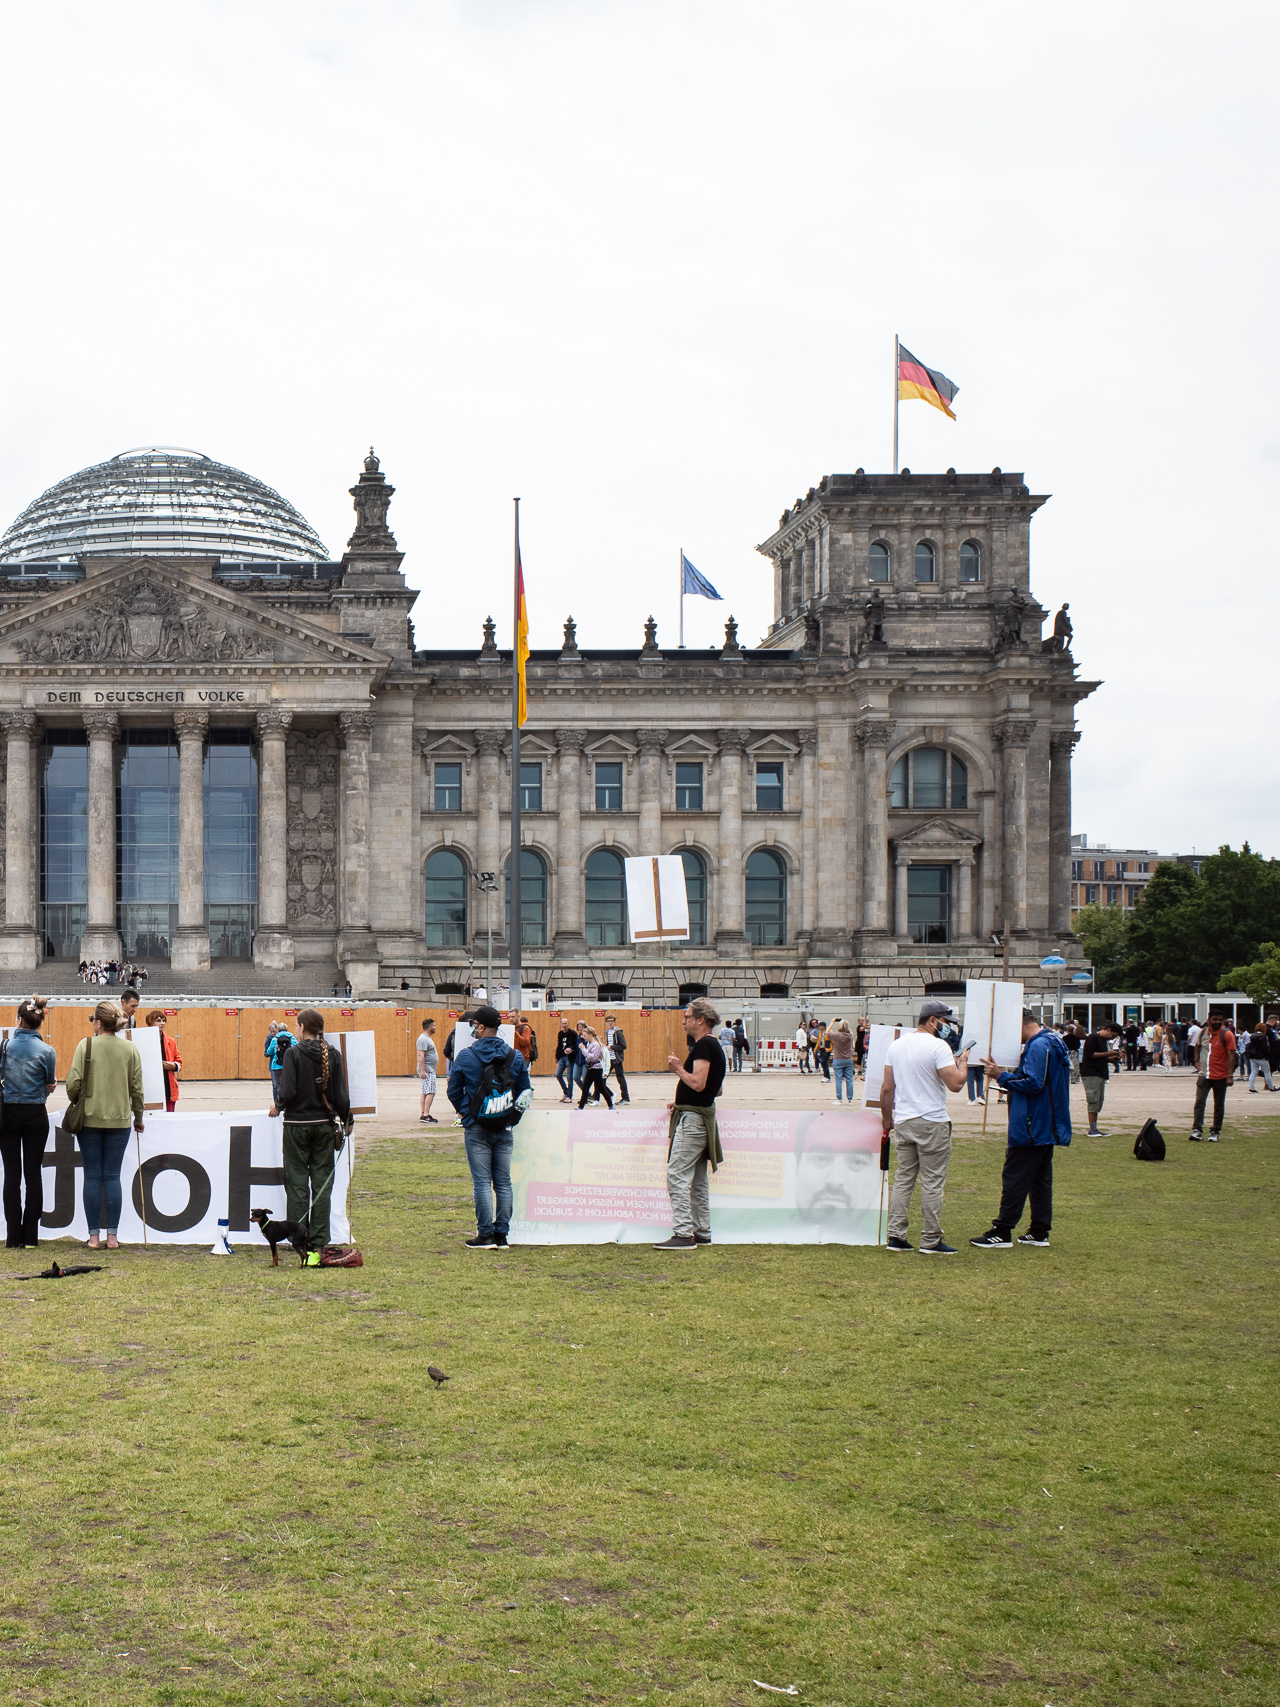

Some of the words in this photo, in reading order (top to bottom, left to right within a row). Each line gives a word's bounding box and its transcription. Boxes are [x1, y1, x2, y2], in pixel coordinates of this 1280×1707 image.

[47, 691, 81, 702] DEM
[94, 691, 184, 702] DEUTSCHEN
[198, 691, 245, 702] VOLKE
